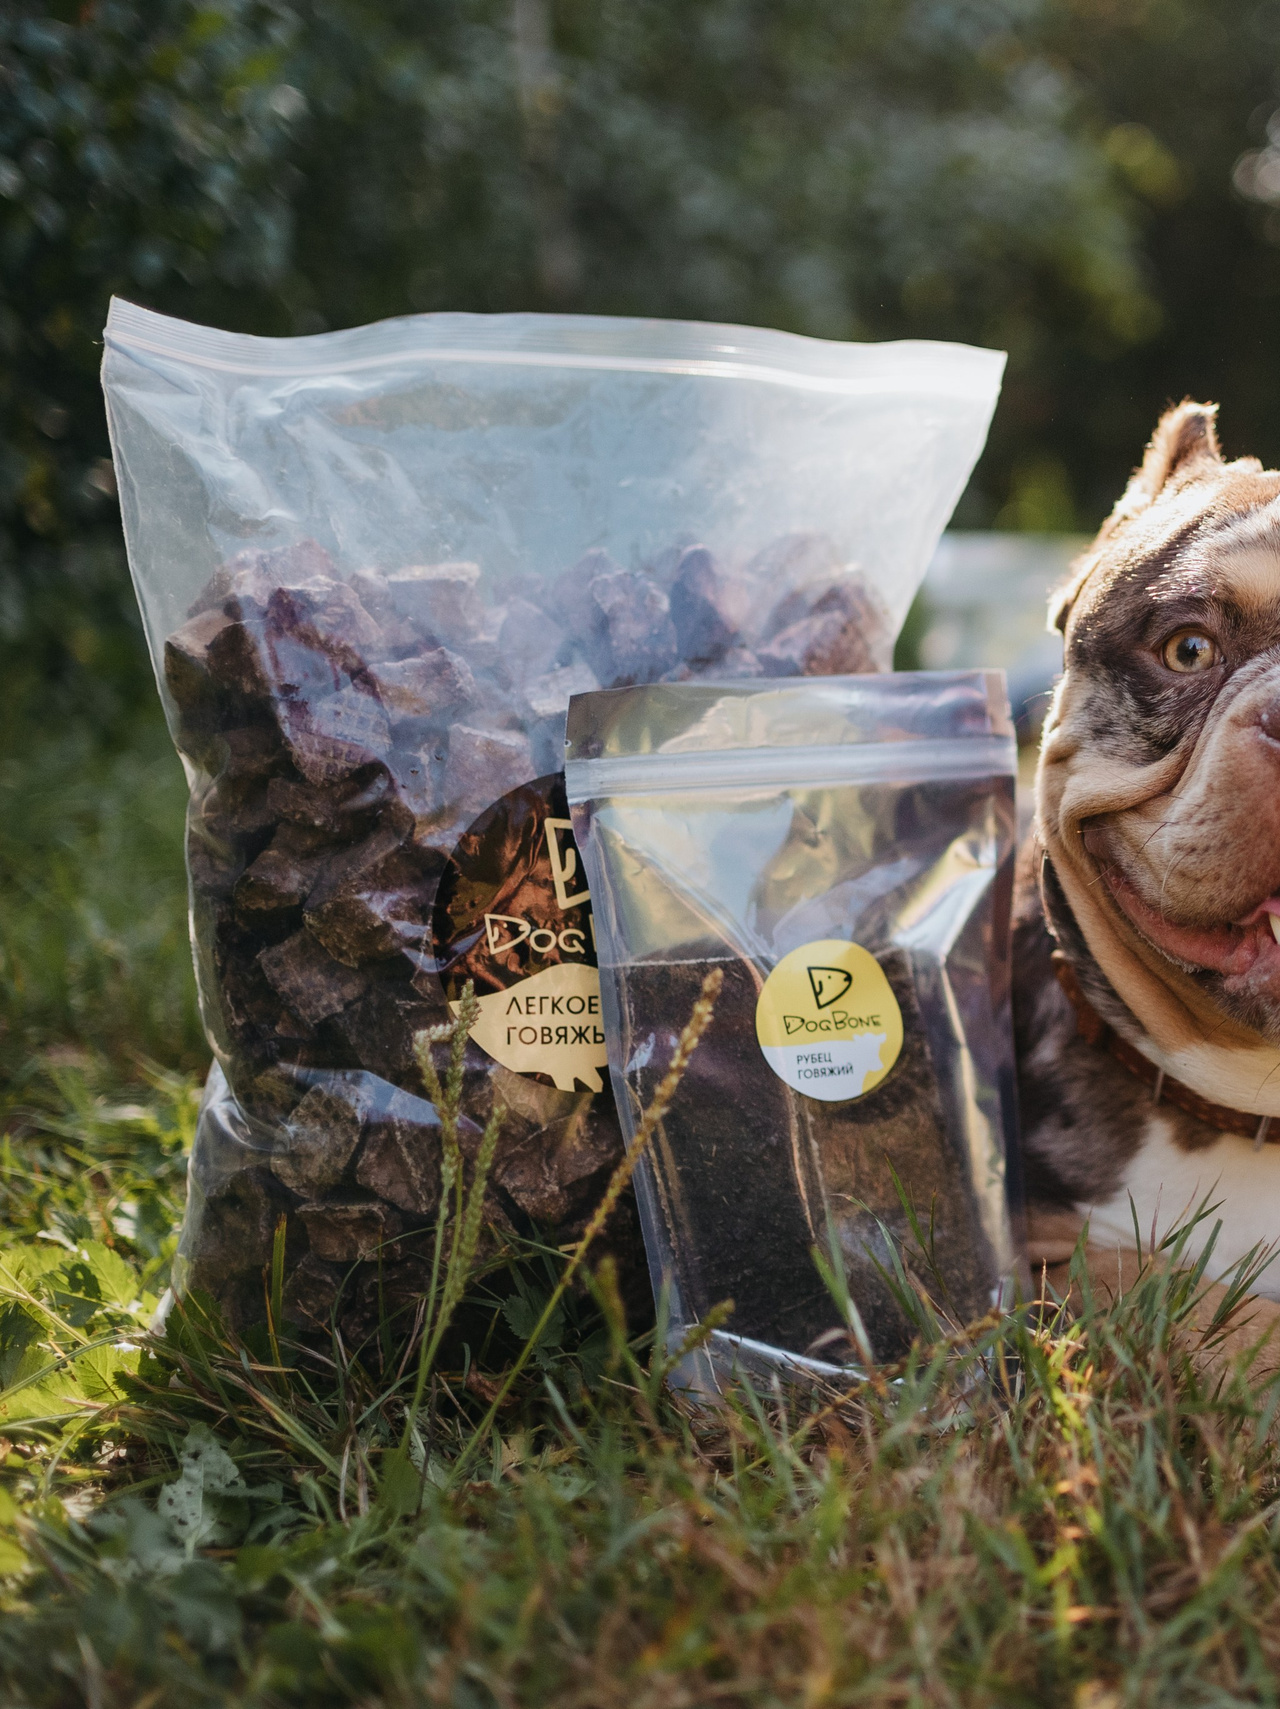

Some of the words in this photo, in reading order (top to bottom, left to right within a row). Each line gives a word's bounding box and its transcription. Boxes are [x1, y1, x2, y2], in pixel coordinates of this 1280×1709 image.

[484, 913, 597, 955] DOG
[506, 995, 599, 1015] ЛЕГКОЕ
[796, 1052, 832, 1065] РУБЕЦ
[798, 1063, 854, 1080] ГОВЯЖИЙ
